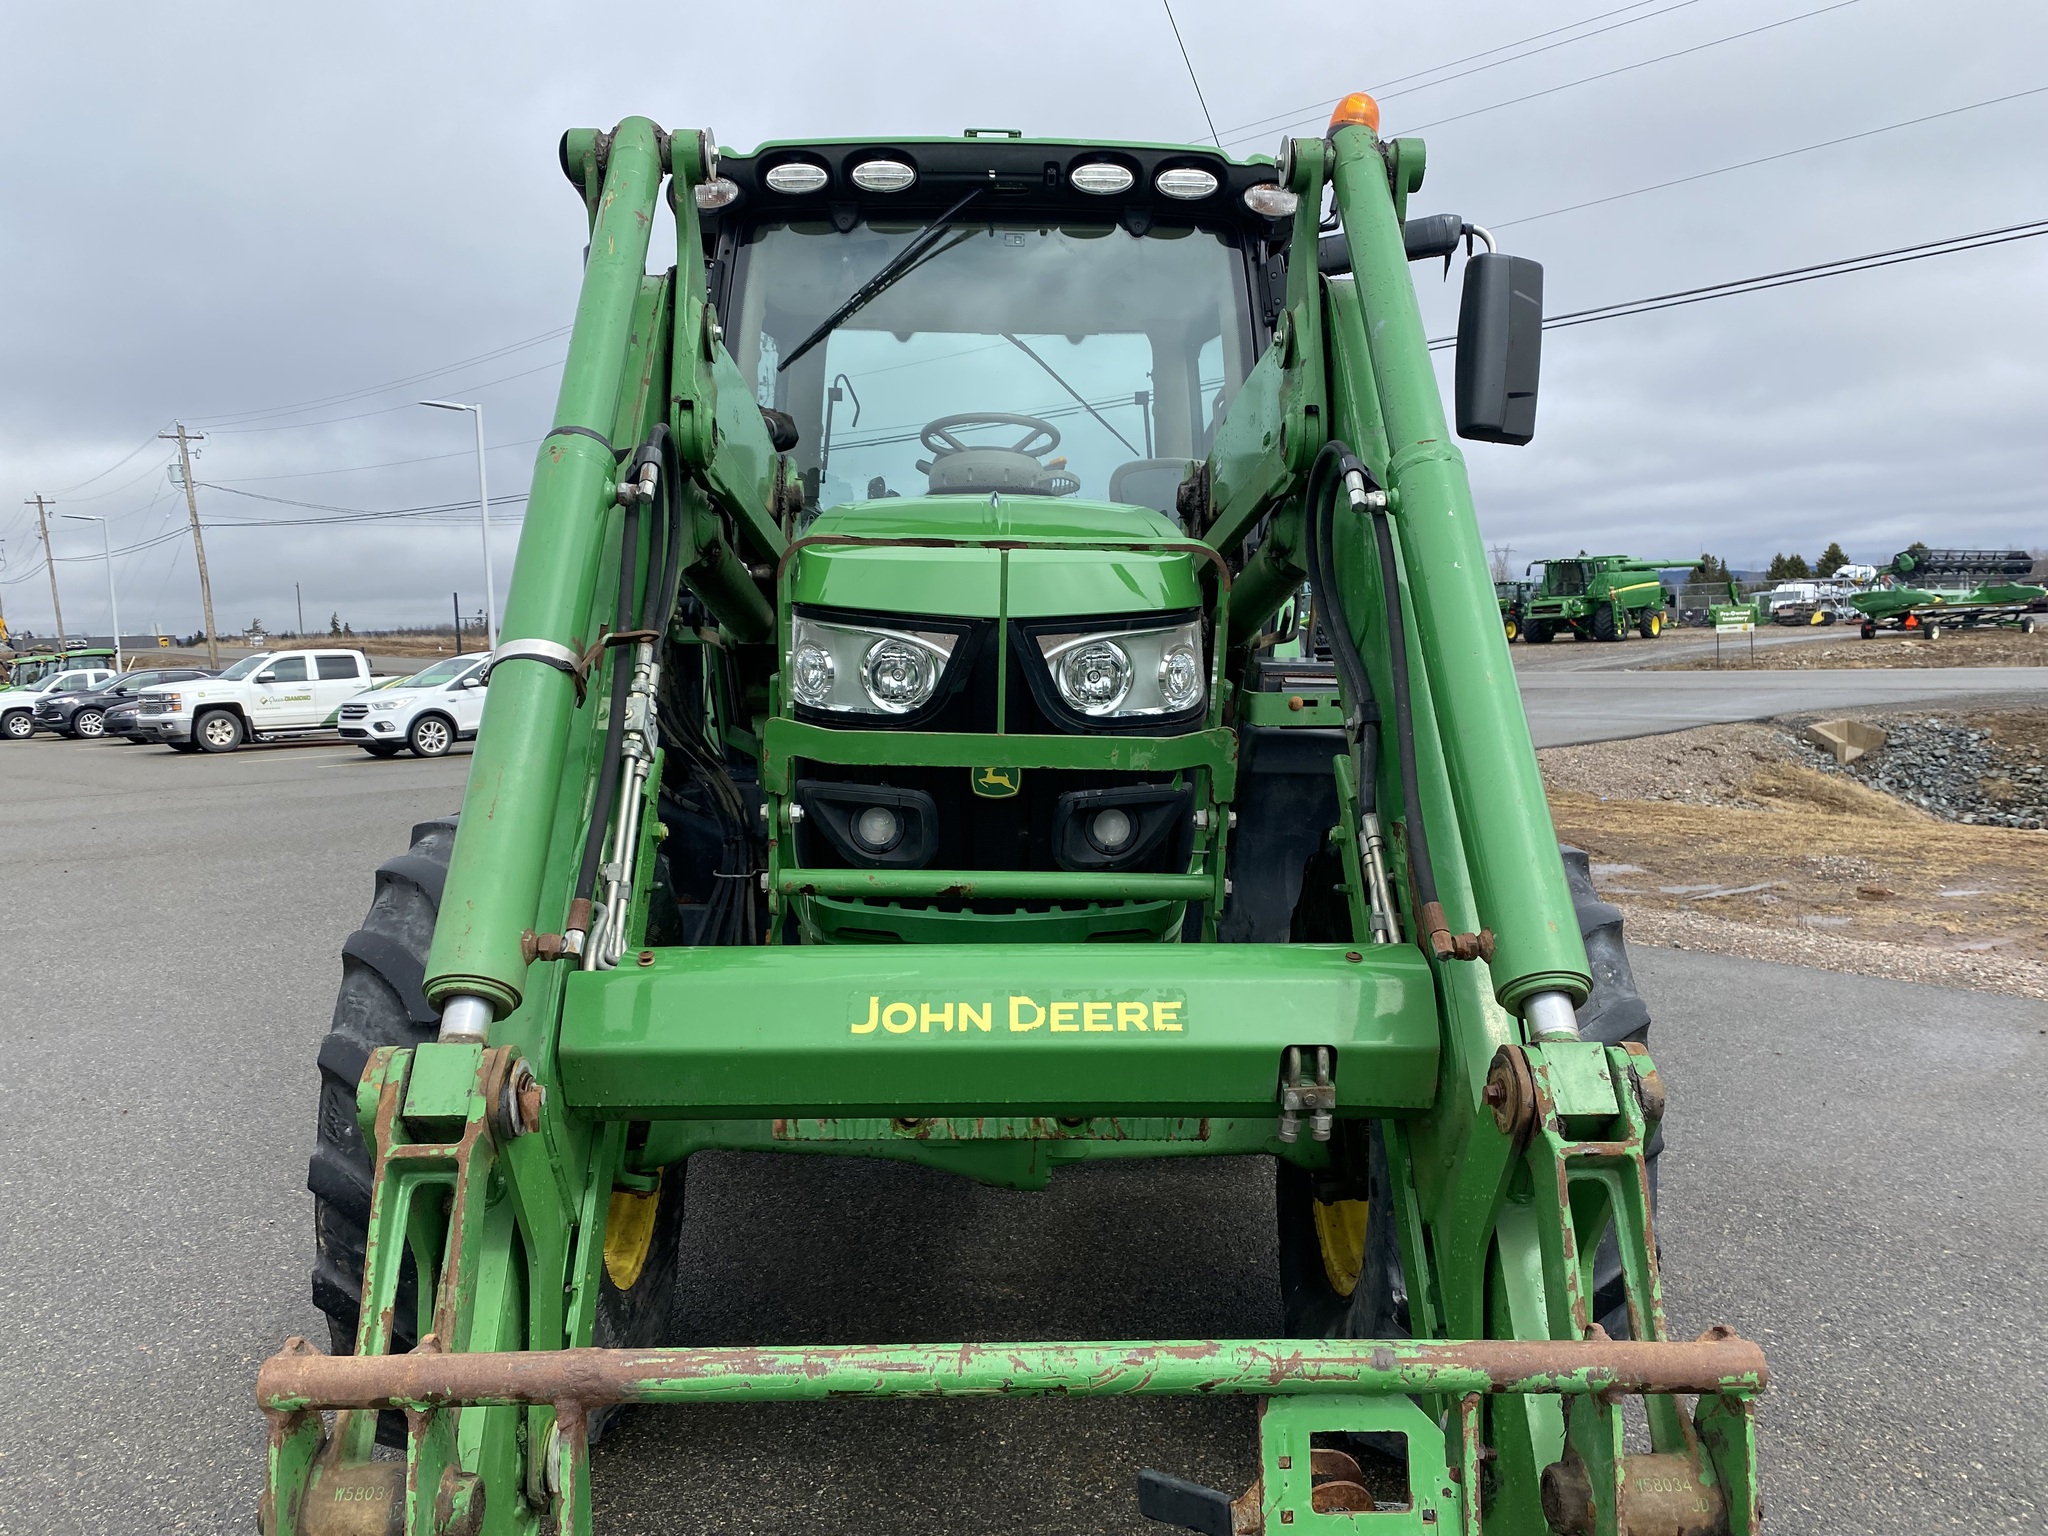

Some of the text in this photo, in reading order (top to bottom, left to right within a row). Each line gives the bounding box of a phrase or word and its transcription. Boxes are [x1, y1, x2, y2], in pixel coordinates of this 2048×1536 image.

[1720, 609, 1751, 617] Pre-Owned
[850, 995, 1184, 1035] JOHN DEERE
